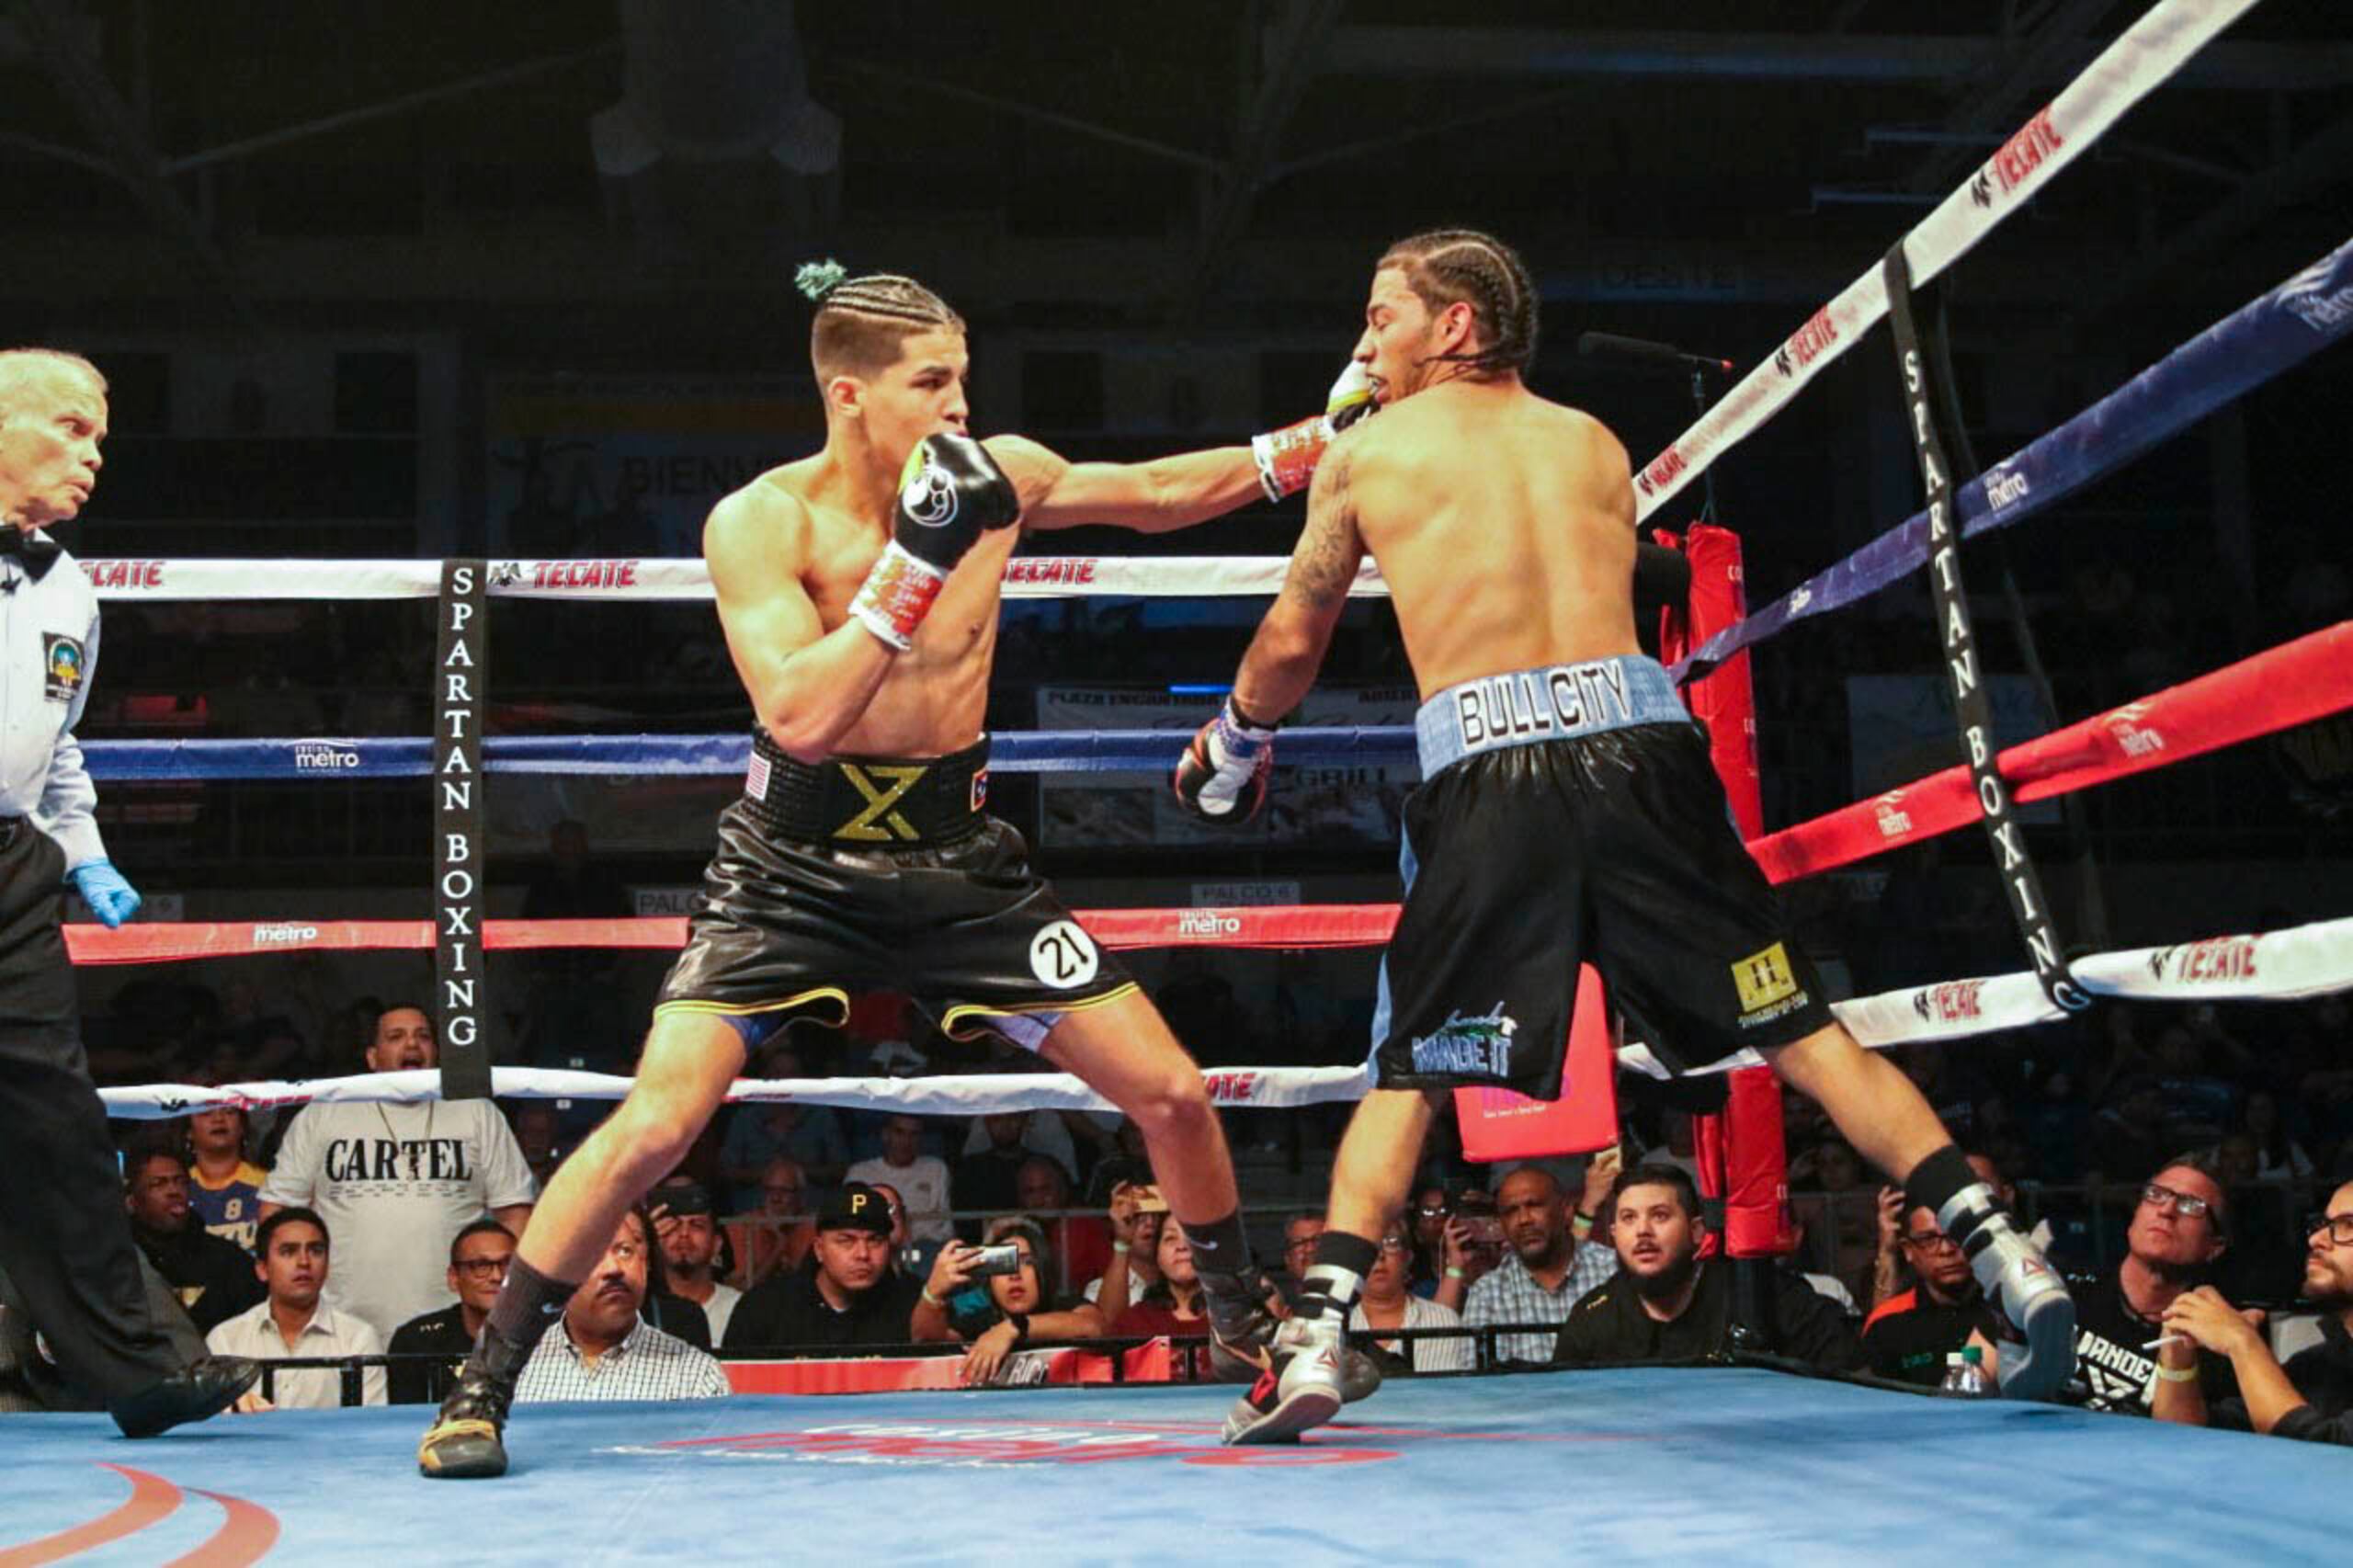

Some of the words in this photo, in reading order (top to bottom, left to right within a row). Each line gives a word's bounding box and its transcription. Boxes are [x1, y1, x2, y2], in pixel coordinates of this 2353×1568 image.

[533, 560, 639, 589] TECATE
[442, 567, 474, 810] SPARTAN
[1458, 675, 1552, 746] BULL
[1548, 658, 1630, 728] CITY
[295, 749, 359, 767] metro
[1965, 725, 2090, 1009] BOXING
[254, 926, 317, 942] metro
[442, 834, 478, 1045] BOXING
[1178, 915, 1242, 934] metro
[1038, 926, 1089, 981] 21
[1411, 1031, 1489, 1074] MADE
[1488, 1036, 1513, 1078] IT
[325, 1138, 474, 1184] CARTEL
[852, 1194, 868, 1214] P
